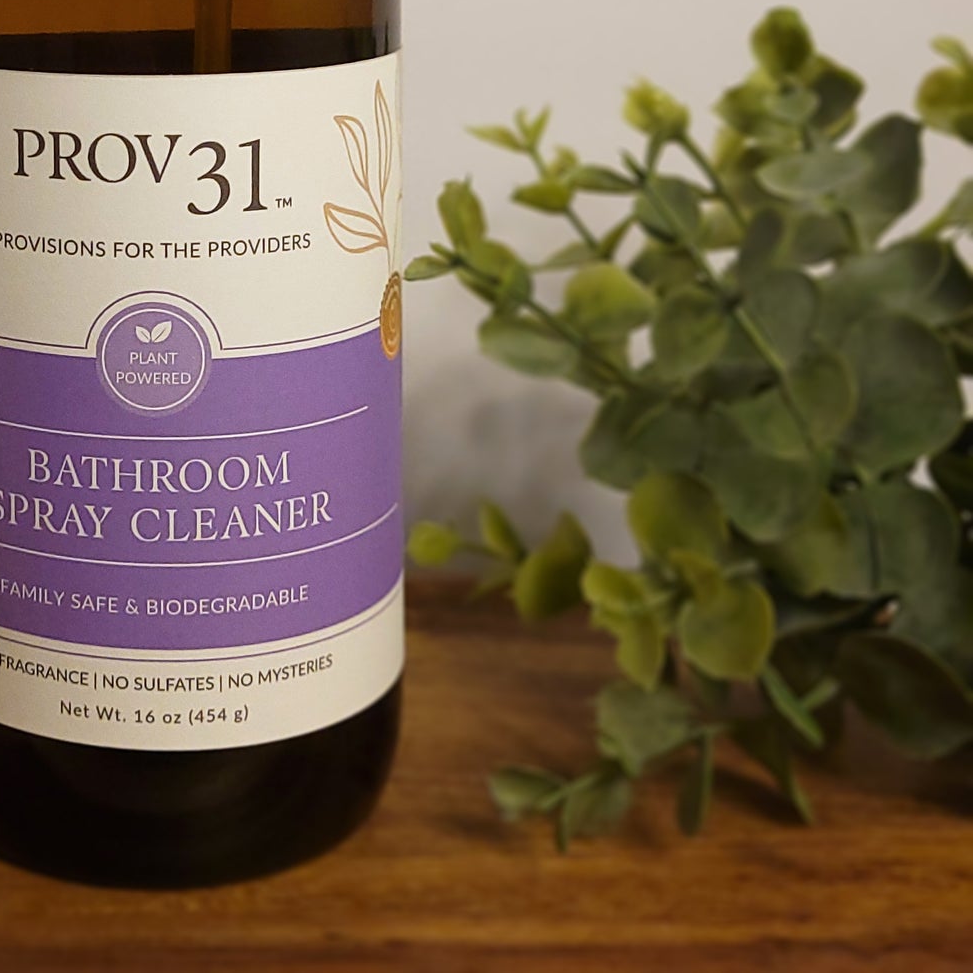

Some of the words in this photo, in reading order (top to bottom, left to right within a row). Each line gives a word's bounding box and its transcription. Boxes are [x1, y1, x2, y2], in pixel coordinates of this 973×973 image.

[13, 127, 182, 184] PROV
[186, 137, 268, 216] 31
[112, 241, 154, 259] FOR
[160, 241, 201, 259] THE
[207, 232, 311, 258] PROVIDERS
[115, 369, 191, 385] POWERED
[129, 351, 177, 366] PLANT
[27, 448, 291, 493] BATHROOM
[130, 490, 333, 543] CLEANER
[0, 577, 65, 608] FAMILY
[71, 593, 119, 614] SAFE
[125, 599, 139, 615] &
[146, 584, 309, 616] BIODEGRADABLE
[102, 674, 128, 690] NO
[133, 675, 214, 692] SULFATES
[228, 673, 253, 688] NO
[258, 653, 333, 686] MYSTERIES
[59, 700, 90, 719] Net
[95, 705, 127, 723] Wt.
[134, 708, 155, 723] 16
[163, 711, 181, 724] oz
[187, 707, 228, 726] (454
[233, 705, 249, 723] g)
